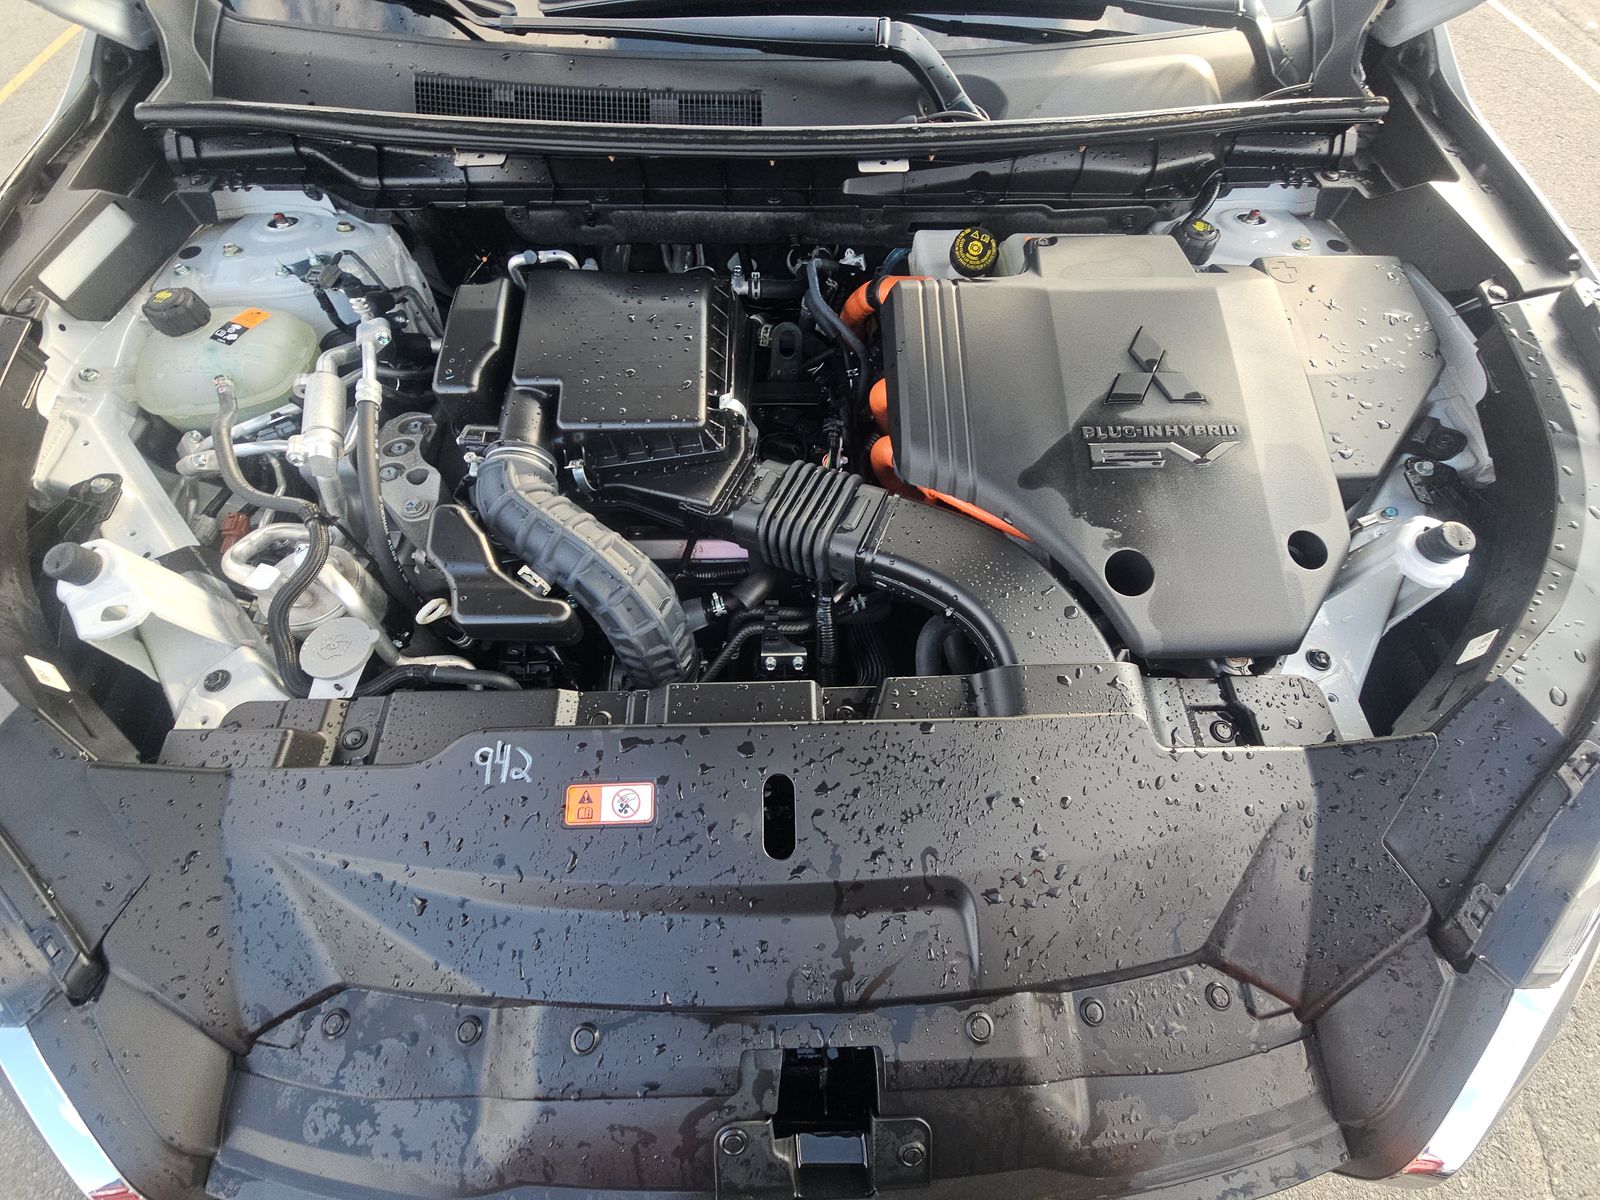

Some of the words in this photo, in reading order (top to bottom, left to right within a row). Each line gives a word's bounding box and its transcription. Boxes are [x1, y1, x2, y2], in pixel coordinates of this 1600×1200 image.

[1081, 425, 1163, 440] PLUG-IN
[1165, 424, 1241, 438] HYBRID
[1087, 441, 1242, 470] EV
[474, 740, 533, 785] 942
